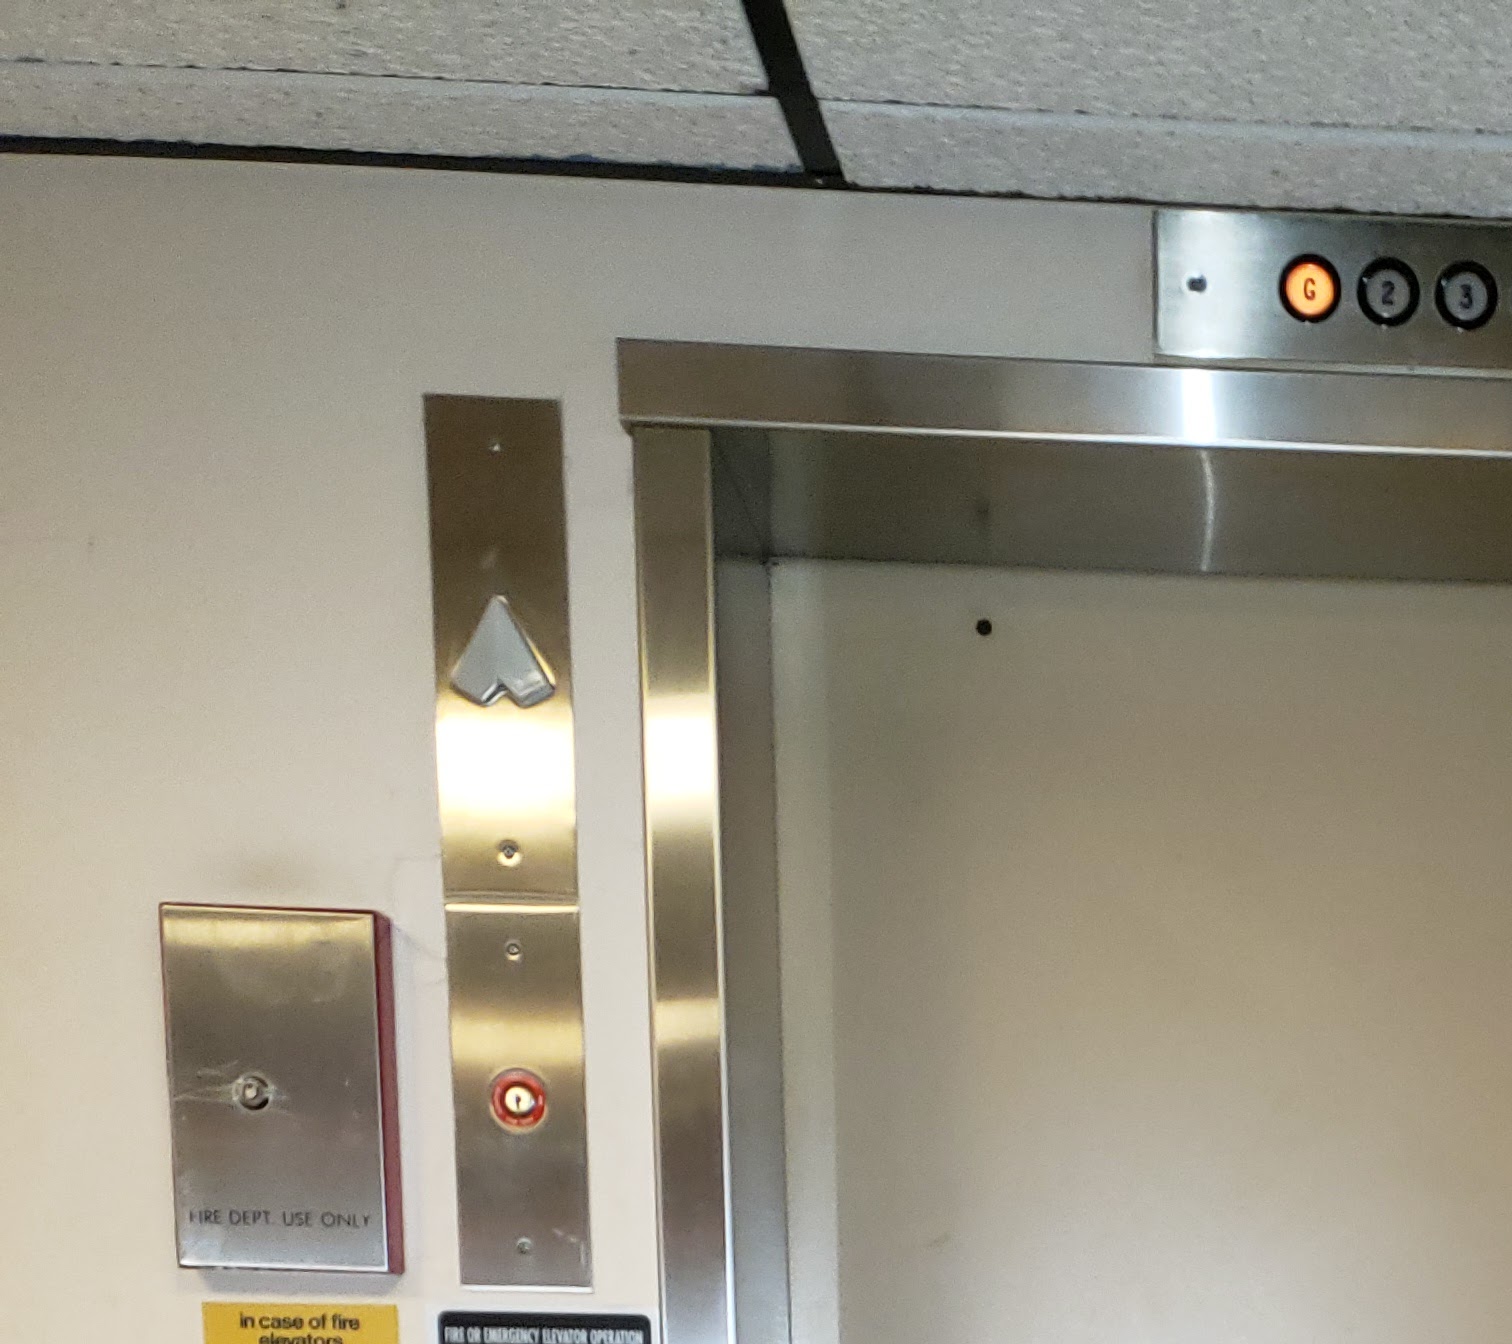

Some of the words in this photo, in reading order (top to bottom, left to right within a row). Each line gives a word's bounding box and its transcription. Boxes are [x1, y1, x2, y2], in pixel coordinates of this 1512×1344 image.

[1303, 277, 1316, 300] G
[1381, 280, 1394, 305] 2
[1460, 284, 1472, 309] 3
[189, 1209, 221, 1225] FIRE
[282, 1211, 312, 1226] USE
[321, 1212, 370, 1228] ONLY
[239, 1311, 255, 1329] in
[258, 1315, 304, 1330] case
[308, 1313, 326, 1329] of
[331, 1314, 360, 1330] fire
[444, 1326, 465, 1344] FIRE
[467, 1327, 482, 1344] OR
